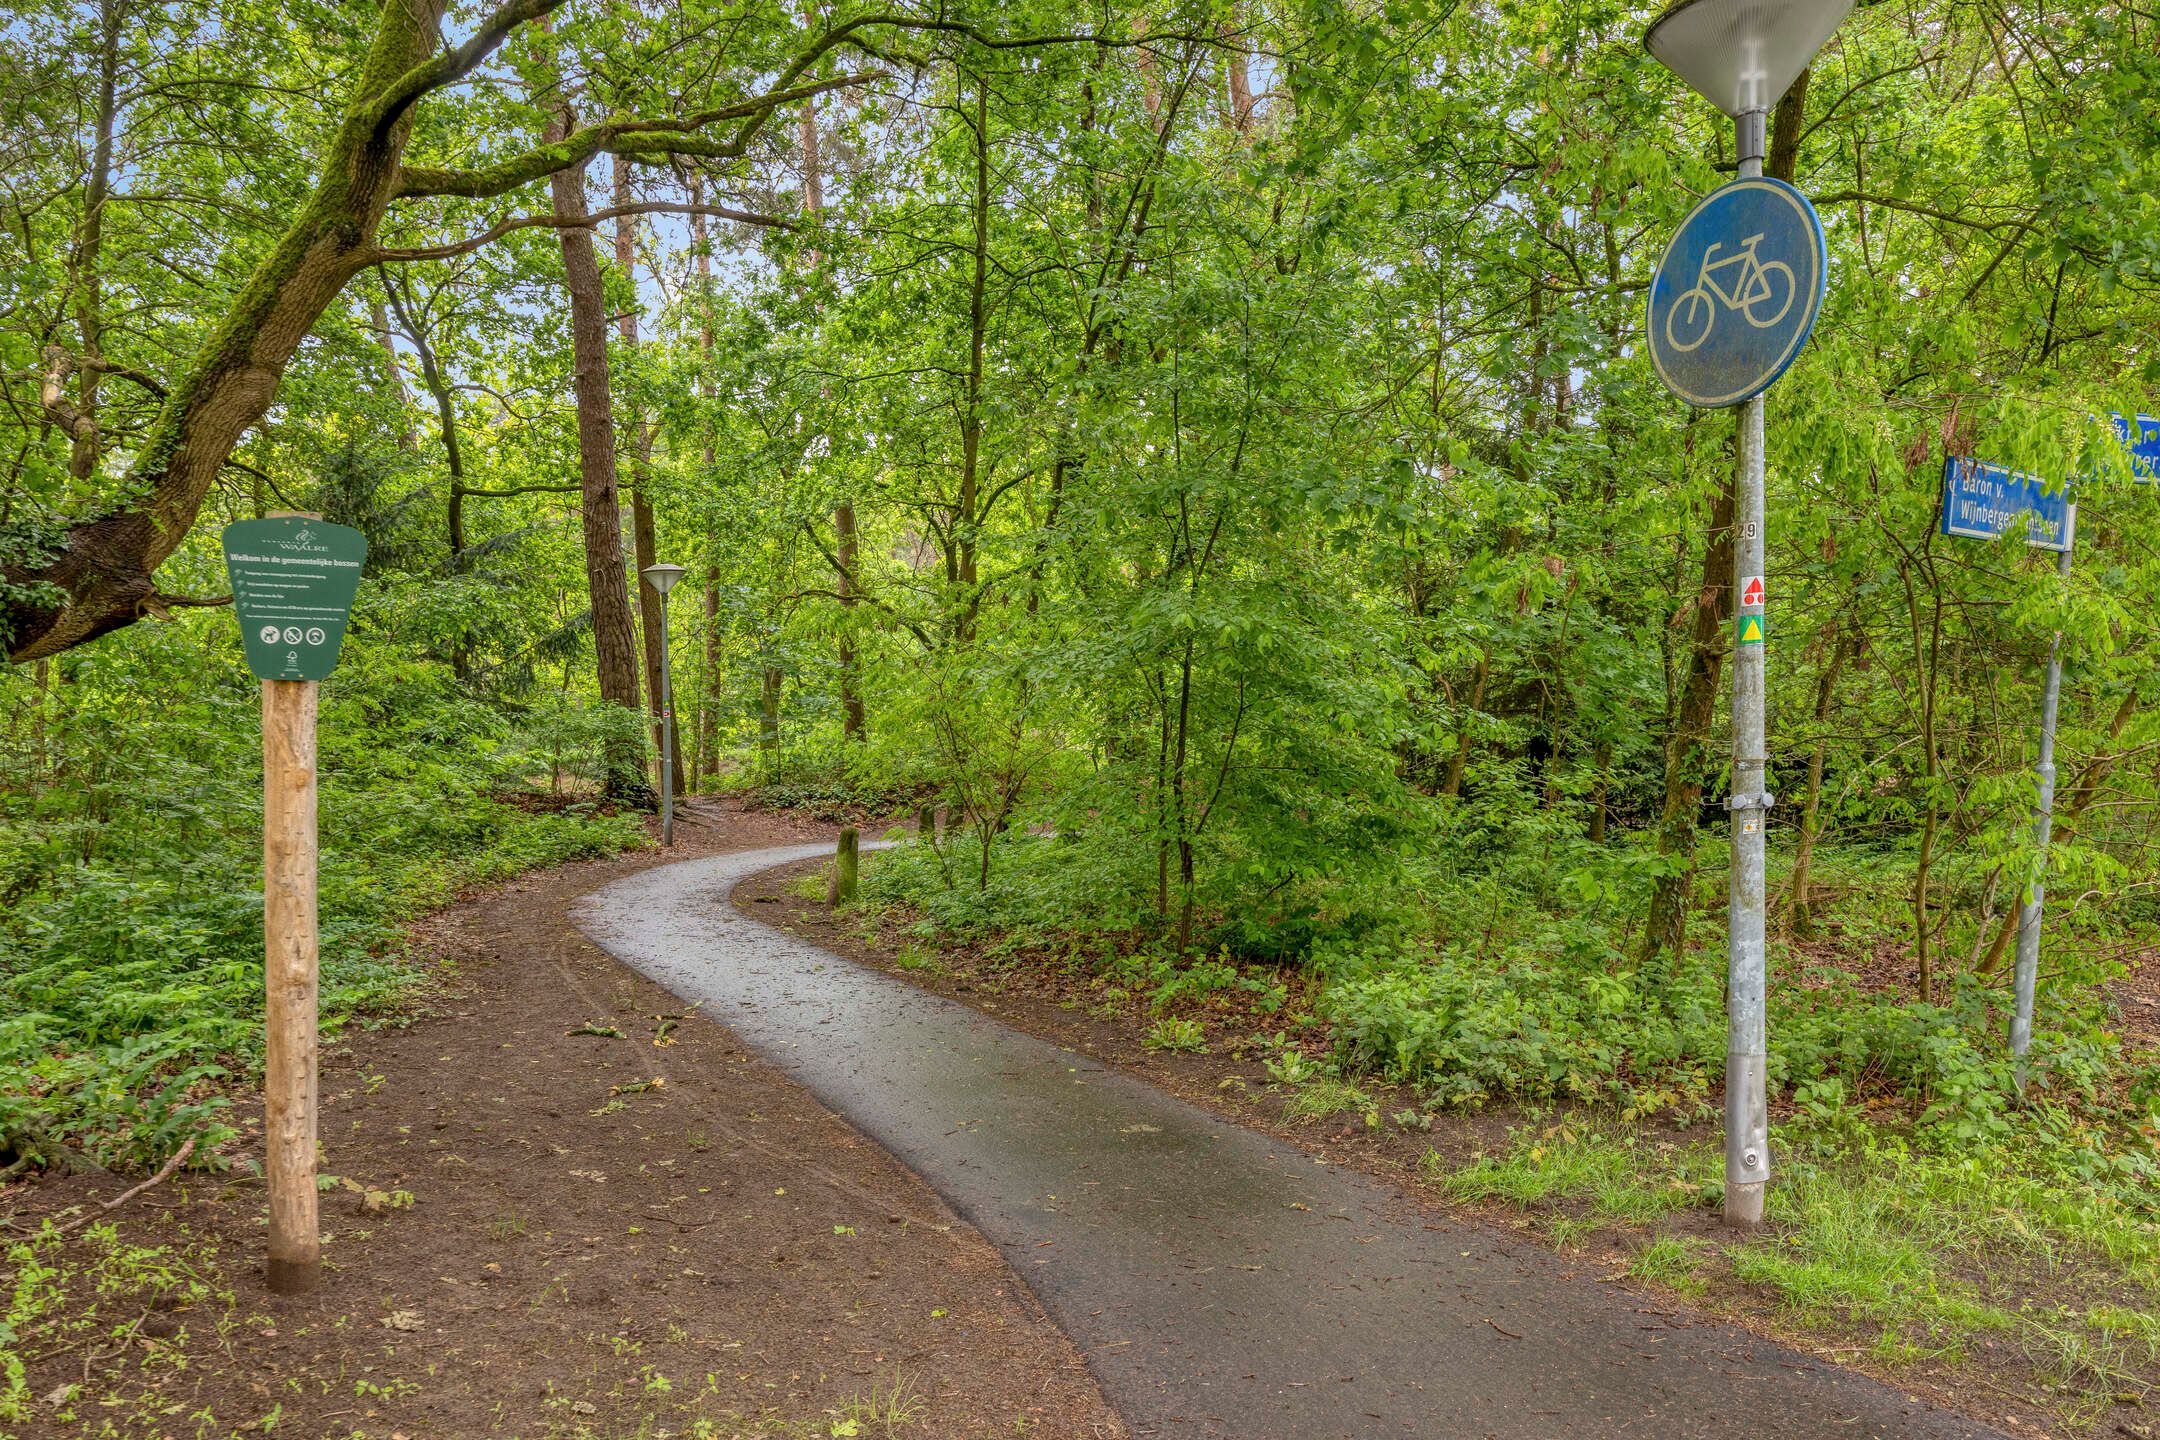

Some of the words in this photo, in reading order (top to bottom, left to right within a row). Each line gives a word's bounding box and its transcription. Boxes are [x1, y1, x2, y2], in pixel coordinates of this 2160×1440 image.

[1996, 483, 2004, 499] v.
[229, 553, 261, 562] Welkom
[281, 558, 333, 567] gemeentelijke
[334, 559, 360, 568] bossen
